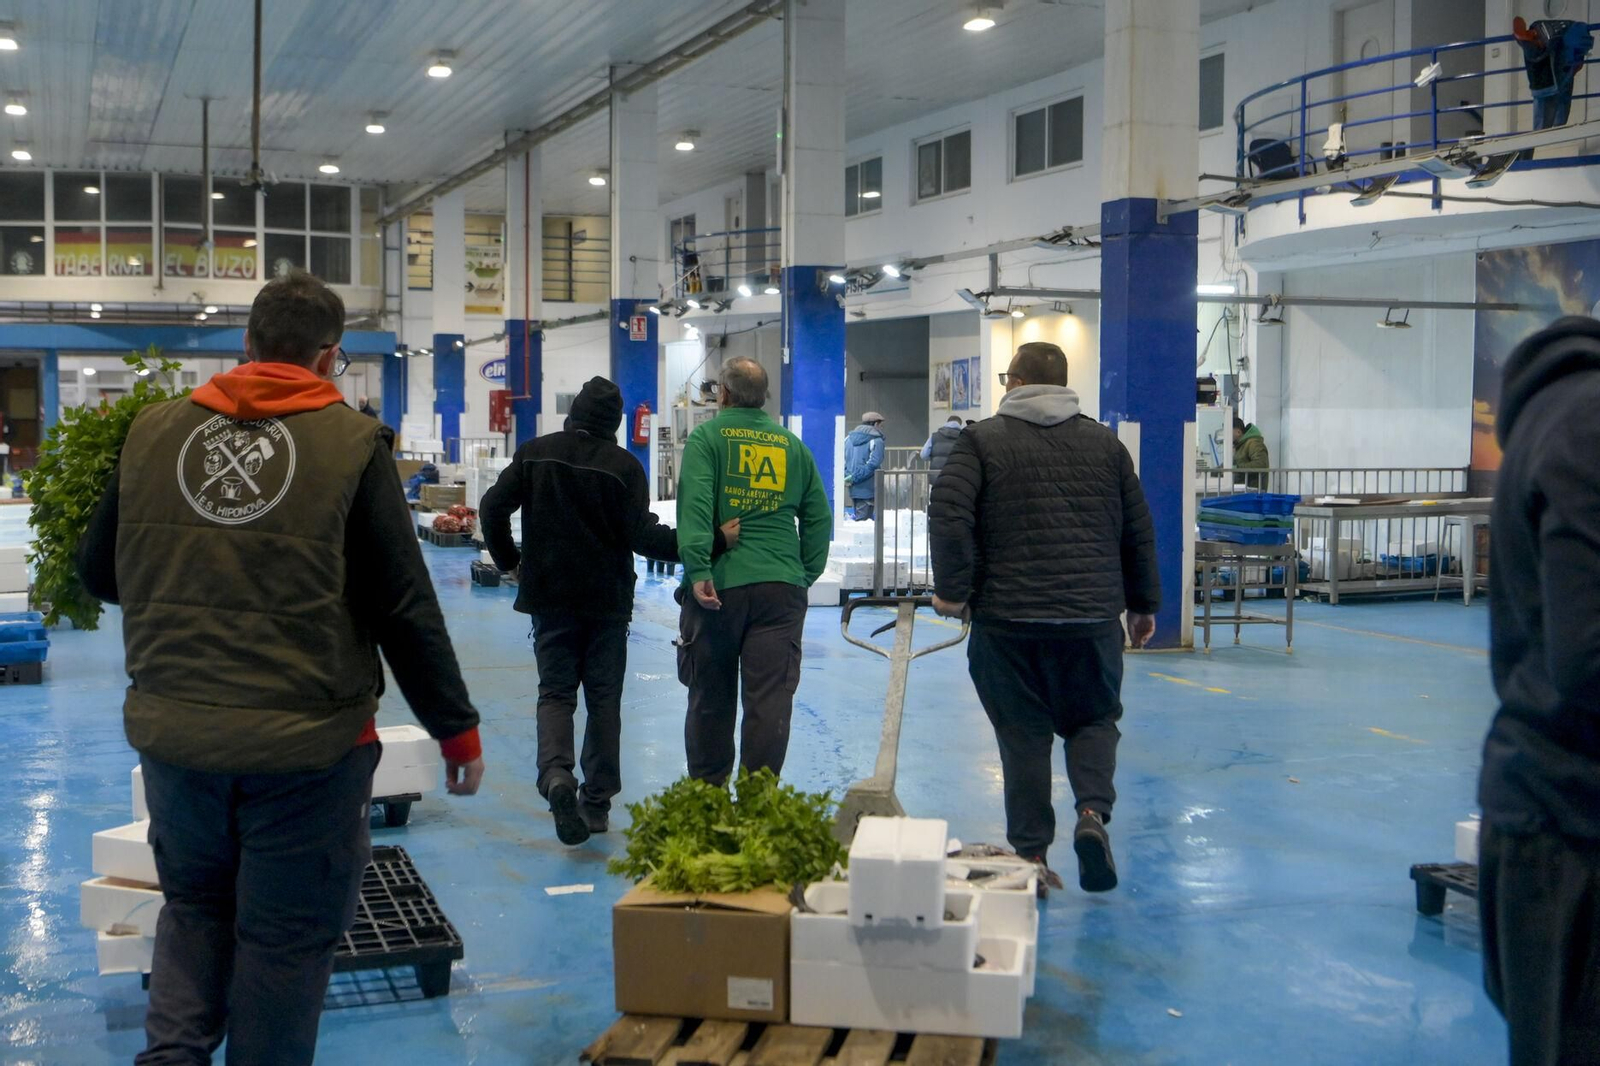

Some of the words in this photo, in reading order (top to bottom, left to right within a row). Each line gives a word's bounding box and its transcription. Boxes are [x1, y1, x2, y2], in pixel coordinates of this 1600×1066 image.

[54, 252, 144, 276] TABERNA
[164, 253, 187, 276] EL
[193, 253, 255, 279] BUZO
[720, 428, 789, 445] CONSTRUCCIONES
[725, 486, 745, 497] RAMOS
[216, 498, 267, 517] HIPONOVA
